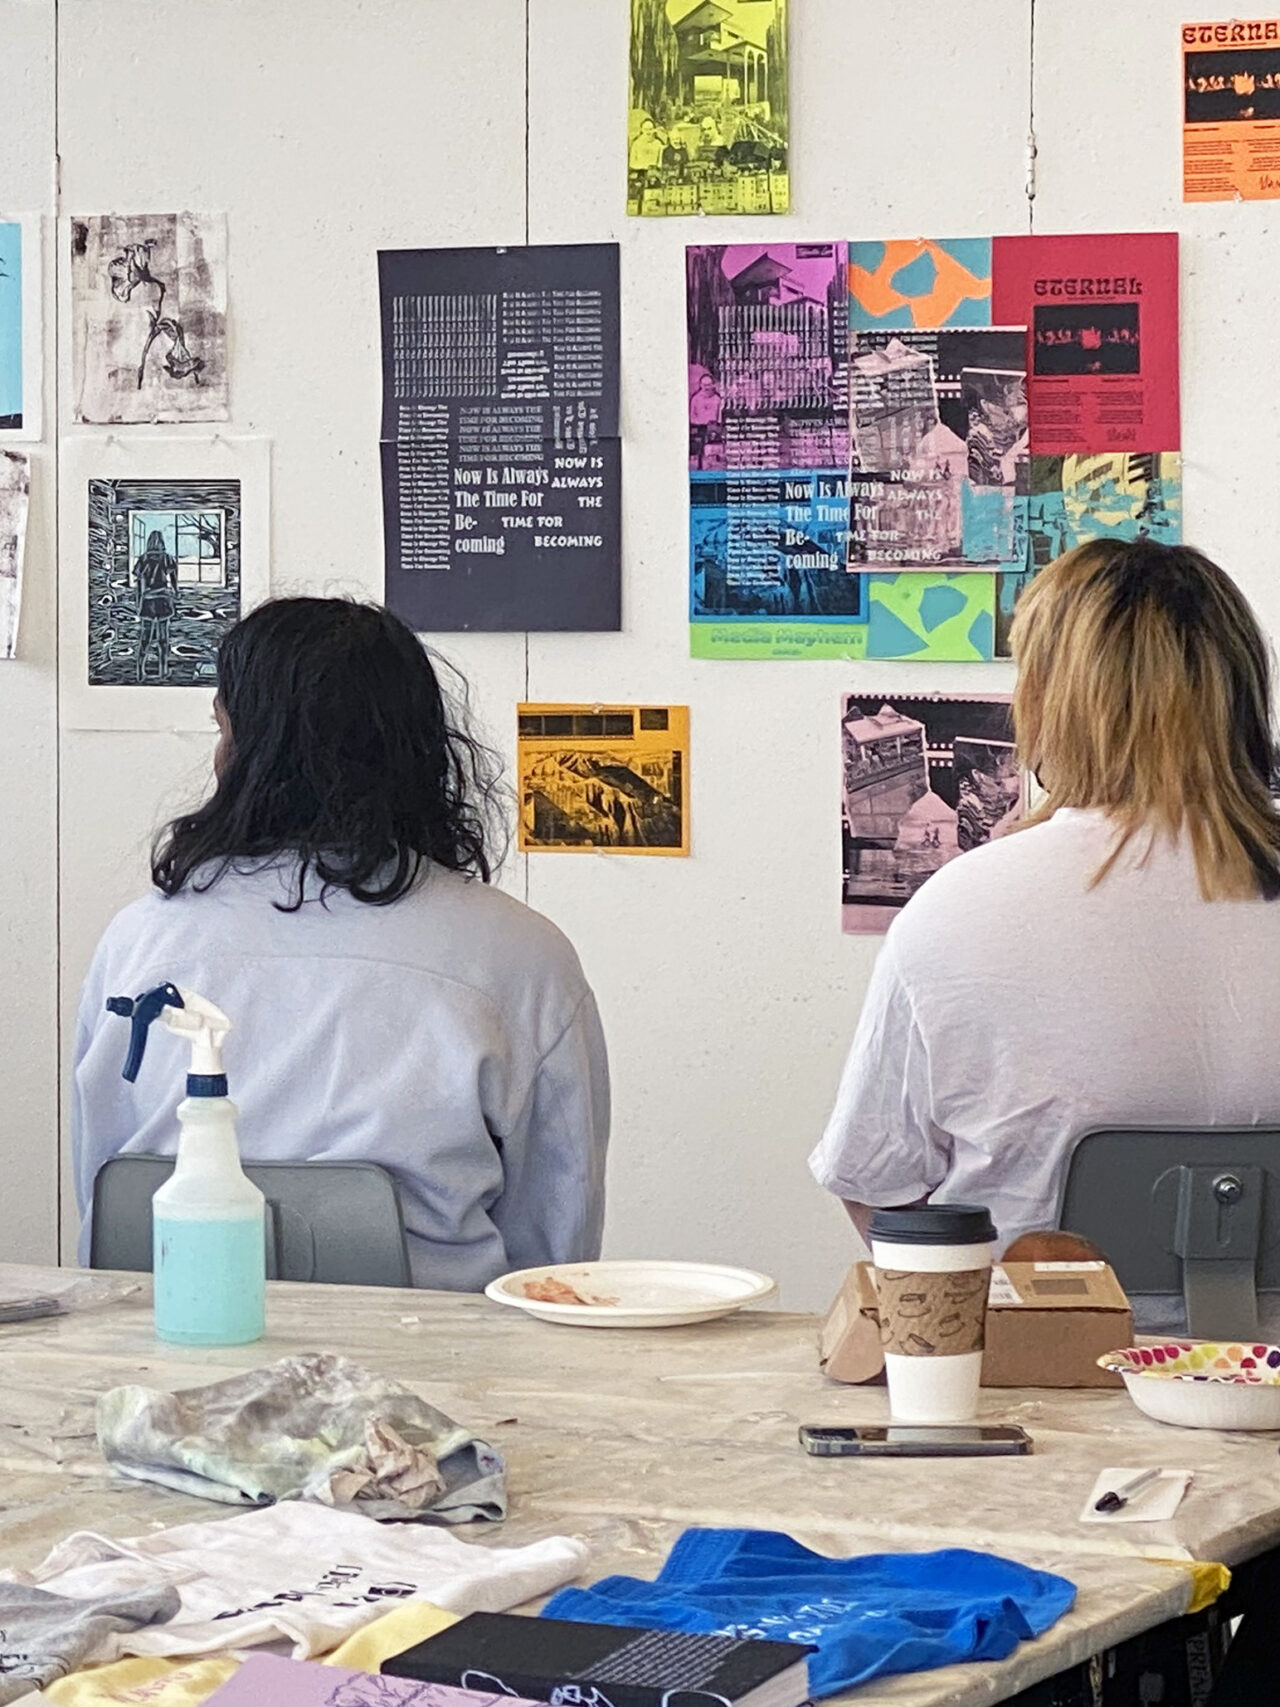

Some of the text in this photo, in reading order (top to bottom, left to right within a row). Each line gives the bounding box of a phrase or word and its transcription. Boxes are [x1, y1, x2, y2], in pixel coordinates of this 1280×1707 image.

[1033, 277, 1143, 296] ETERNAL
[554, 456, 603, 468] NOW IS
[453, 466, 549, 485] Now Is Always
[551, 476, 603, 489] ALWAYS
[890, 469, 921, 481] NOW
[453, 490, 544, 508] The Time For
[785, 481, 815, 499] Now
[819, 481, 832, 498] Is
[577, 496, 603, 508] THE
[785, 505, 812, 522] The
[854, 503, 878, 521] For
[454, 513, 478, 531] Be-
[501, 516, 563, 528] TIME FOR
[454, 536, 505, 555] coming
[534, 535, 603, 547] BECOMING
[785, 529, 810, 546] Be-
[785, 551, 839, 571] coming
